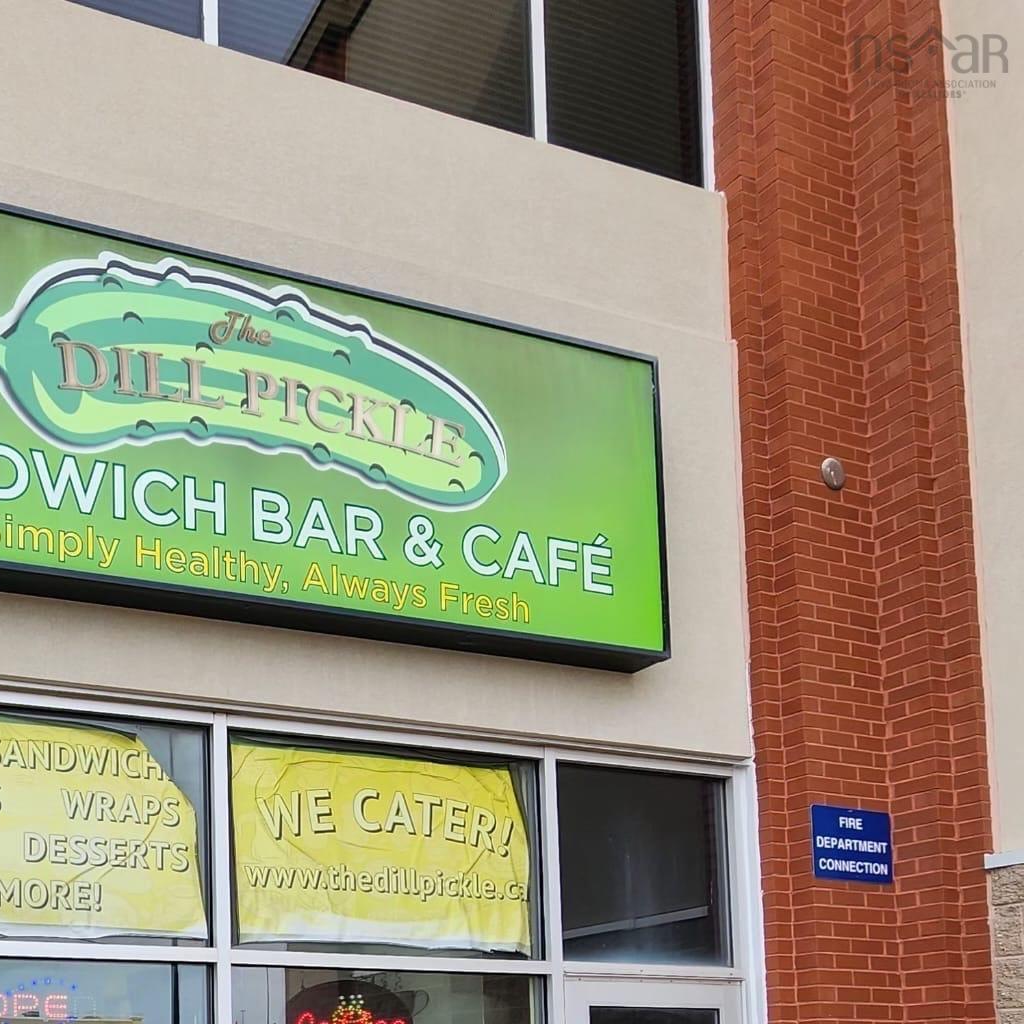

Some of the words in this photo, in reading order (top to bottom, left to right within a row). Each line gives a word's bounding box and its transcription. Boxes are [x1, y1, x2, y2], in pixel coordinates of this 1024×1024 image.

[209, 310, 273, 348] The
[52, 338, 225, 410] DILL
[240, 366, 466, 468] PICKLE
[250, 487, 387, 561] BAR
[403, 514, 445, 569] &
[462, 524, 614, 596] CAFÉ
[134, 535, 289, 594] Healthy,
[302, 562, 427, 611] Always
[439, 581, 530, 624] Fresh
[60, 788, 181, 828] WRAPS
[256, 788, 336, 841] WE
[352, 787, 515, 858] CATER!
[839, 816, 863, 830] FIRE
[23, 831, 190, 873] DESSERTS
[816, 835, 888, 854] DEPARTMENT
[819, 857, 888, 875] CONNECTION
